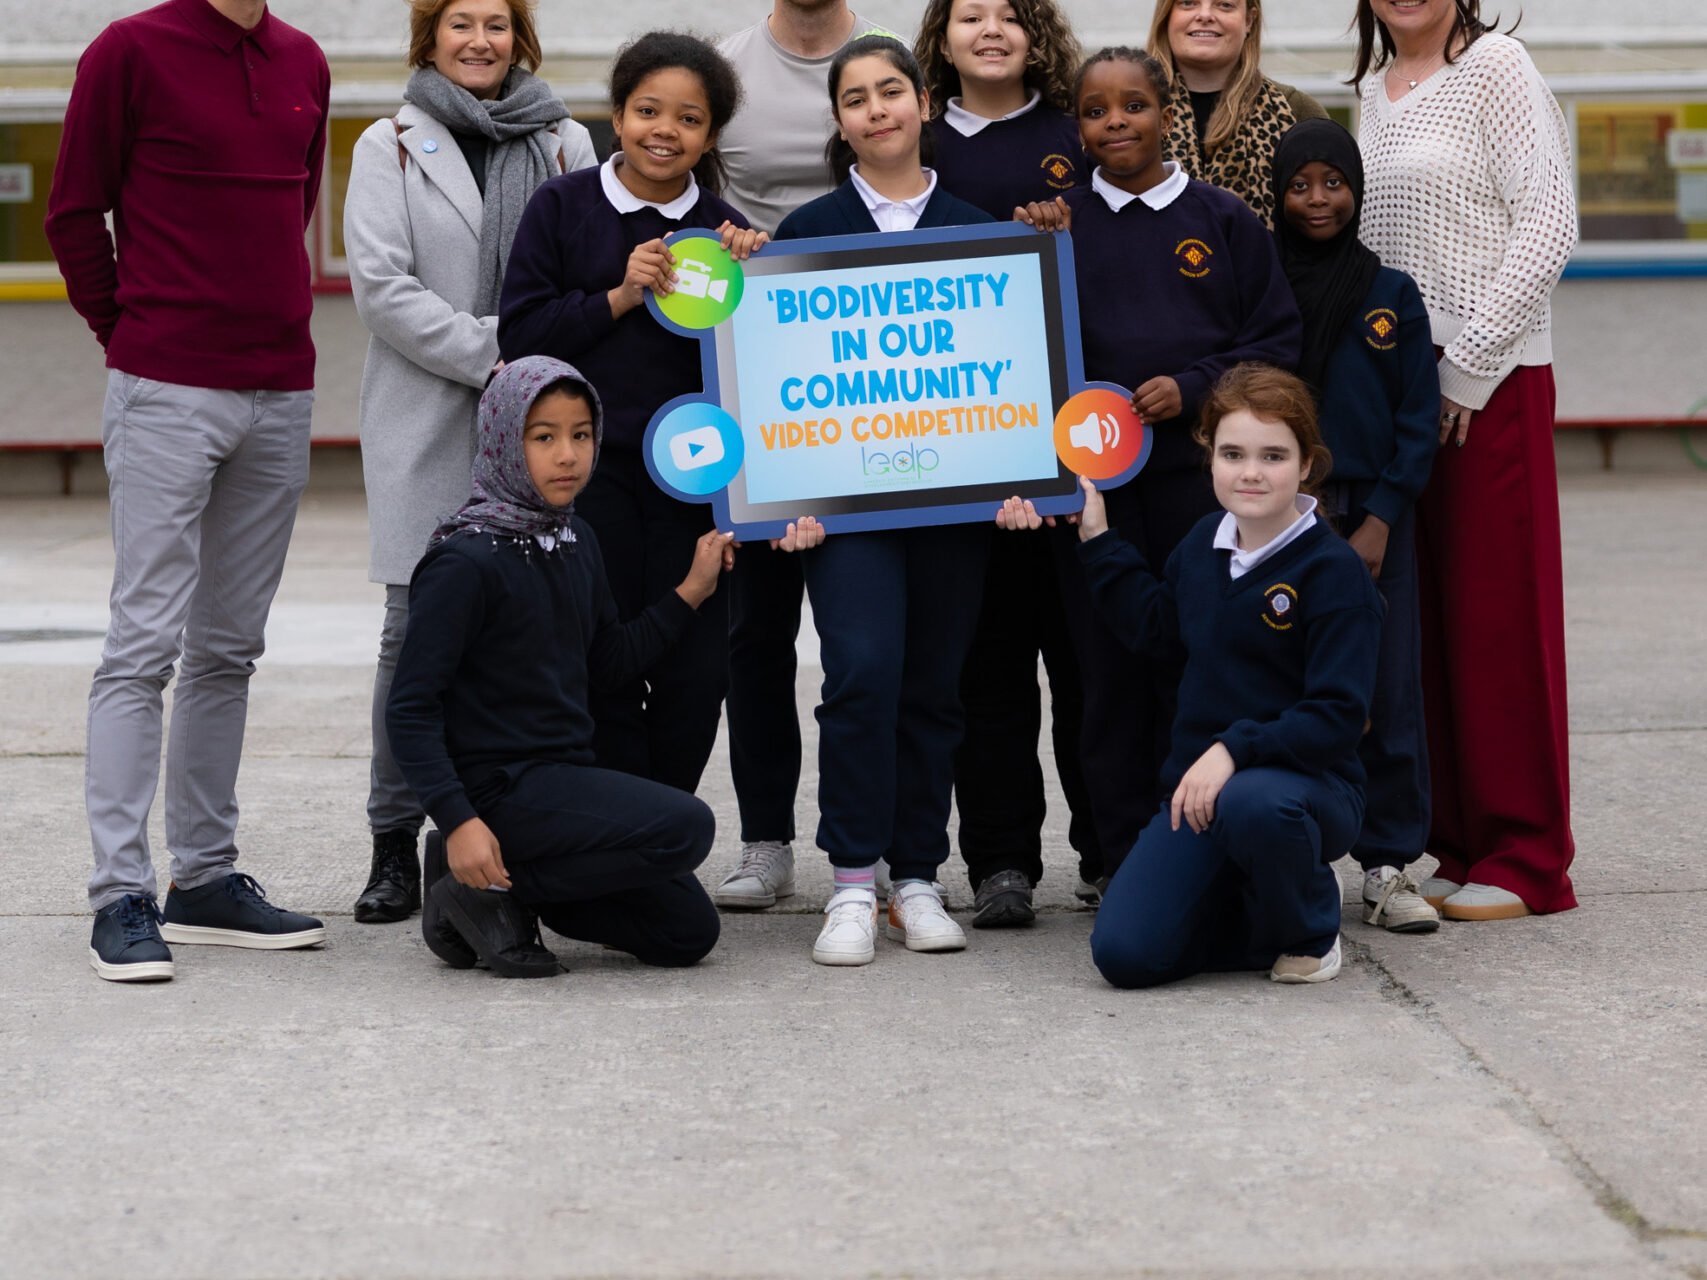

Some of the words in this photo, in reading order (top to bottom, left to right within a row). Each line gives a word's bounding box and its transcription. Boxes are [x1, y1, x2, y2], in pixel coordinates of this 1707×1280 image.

[831, 328, 868, 364] IN
[878, 318, 956, 359] OUR
[760, 417, 843, 451] VIDEO
[851, 402, 1039, 443] COMPETITION
